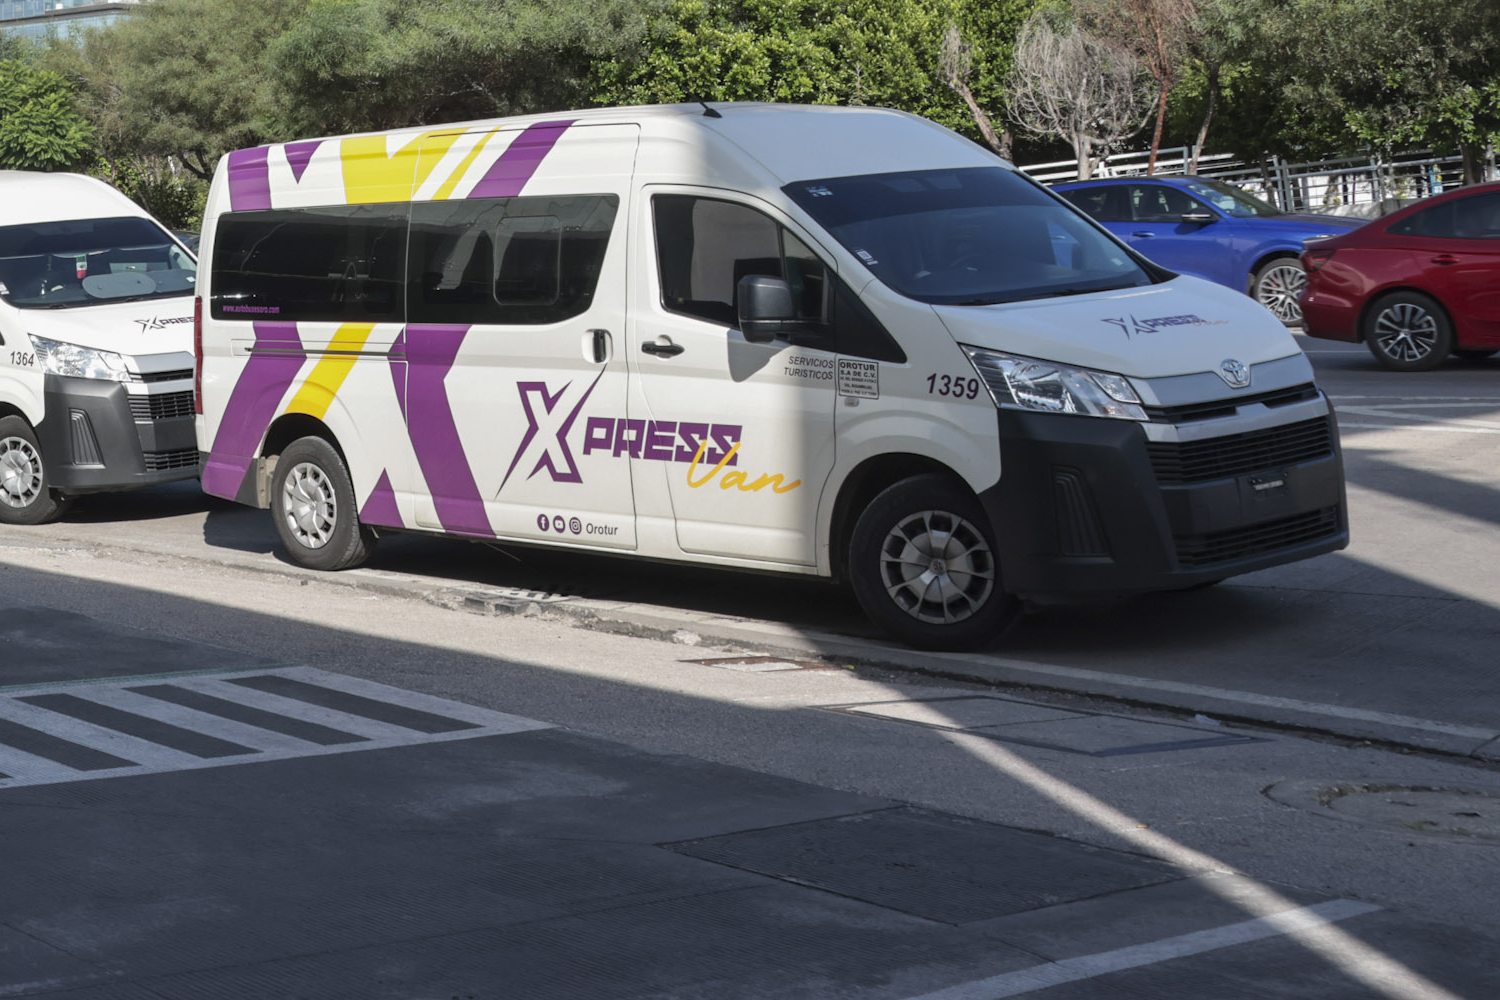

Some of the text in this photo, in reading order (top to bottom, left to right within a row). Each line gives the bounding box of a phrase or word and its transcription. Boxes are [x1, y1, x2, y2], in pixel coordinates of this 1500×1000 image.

[10, 351, 35, 366] 1364
[788, 356, 834, 369] SERVICIOS
[784, 367, 833, 380] TURISTICOS
[840, 361, 876, 372] OROTUR
[926, 373, 979, 400] 1359
[495, 362, 743, 500] XPRESS
[687, 439, 802, 494] Van
[586, 523, 618, 536] Orotur
